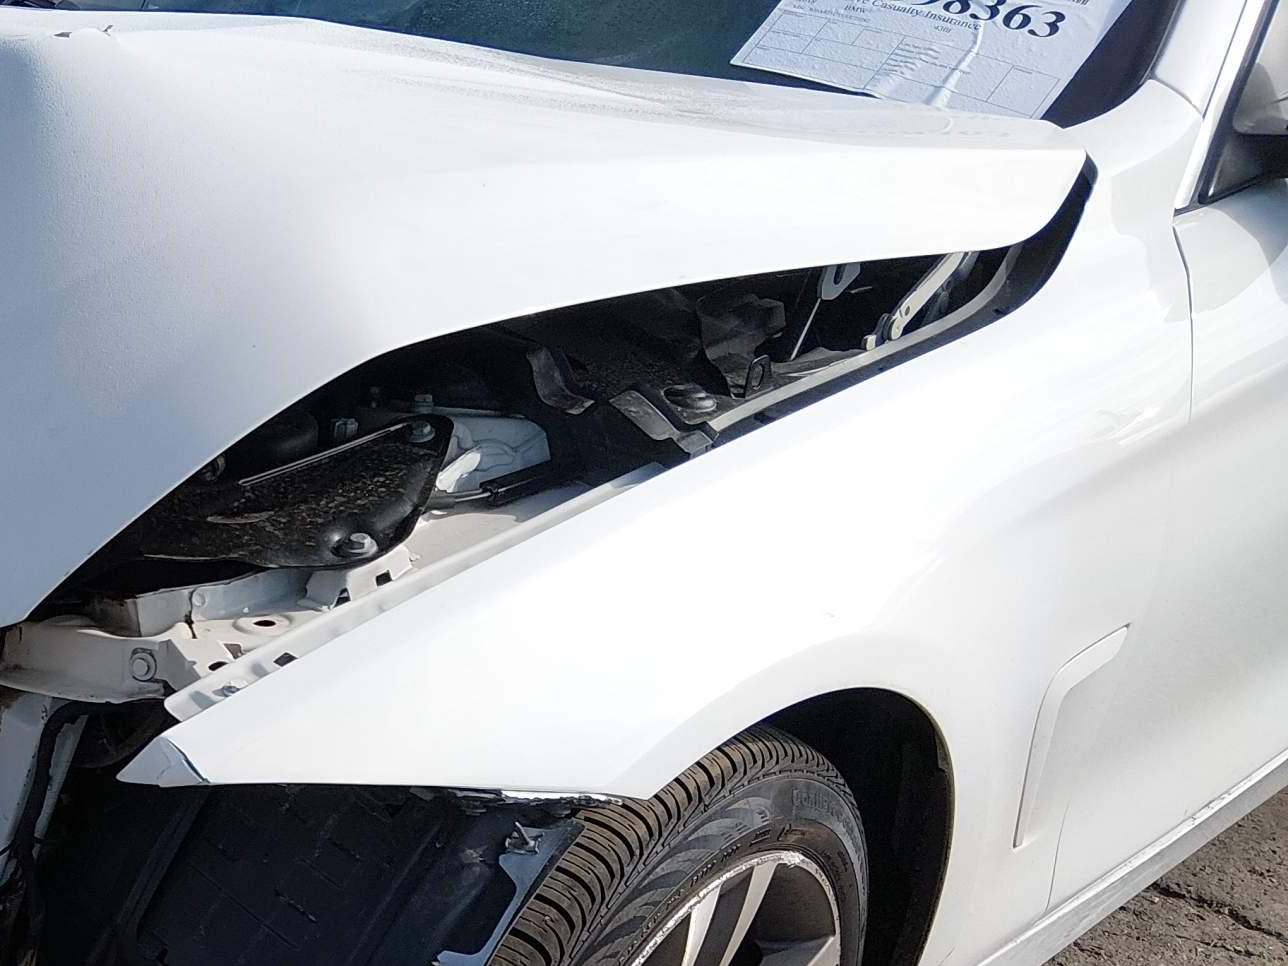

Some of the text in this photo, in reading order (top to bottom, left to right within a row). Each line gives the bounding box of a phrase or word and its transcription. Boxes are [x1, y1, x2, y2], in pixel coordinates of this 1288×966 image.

[872, 0, 921, 17] Casualty
[924, 10, 982, 31] Insurance
[911, 0, 1066, 38] 8363
